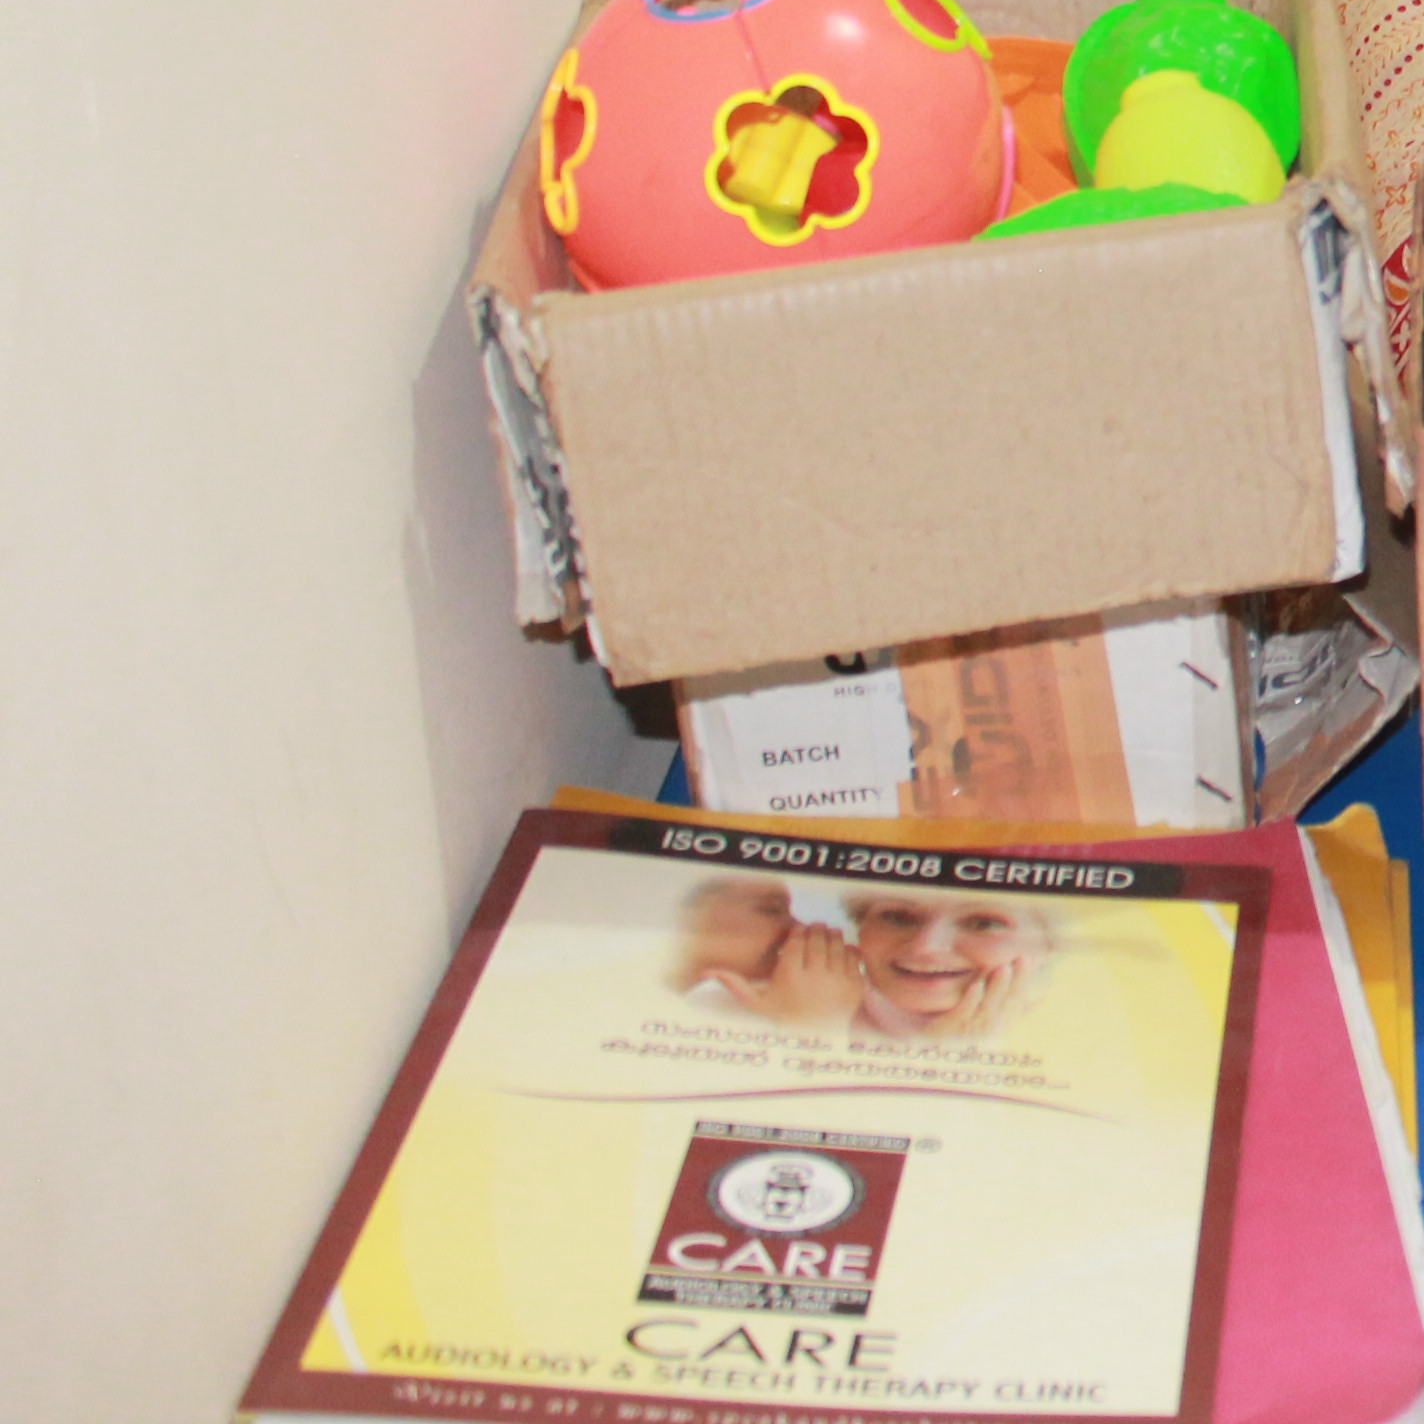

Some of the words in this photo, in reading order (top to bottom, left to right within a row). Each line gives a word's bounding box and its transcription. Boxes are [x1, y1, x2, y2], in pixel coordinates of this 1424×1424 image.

[834, 684, 878, 698] HIG
[762, 743, 841, 768] BATCH
[769, 786, 882, 812] QUANTITY
[661, 827, 728, 855] ISO
[739, 838, 942, 879] 9001:2008
[953, 859, 1136, 891] CERTIFIED
[667, 1231, 874, 1282] CARE
[625, 1318, 899, 1372] CARE
[381, 1342, 598, 1376] AUDIOLOGY
[612, 1354, 636, 1380] &
[653, 1361, 796, 1394] SPEECH
[813, 1374, 981, 1402] THERAPY
[994, 1382, 1110, 1404] CLINIC
